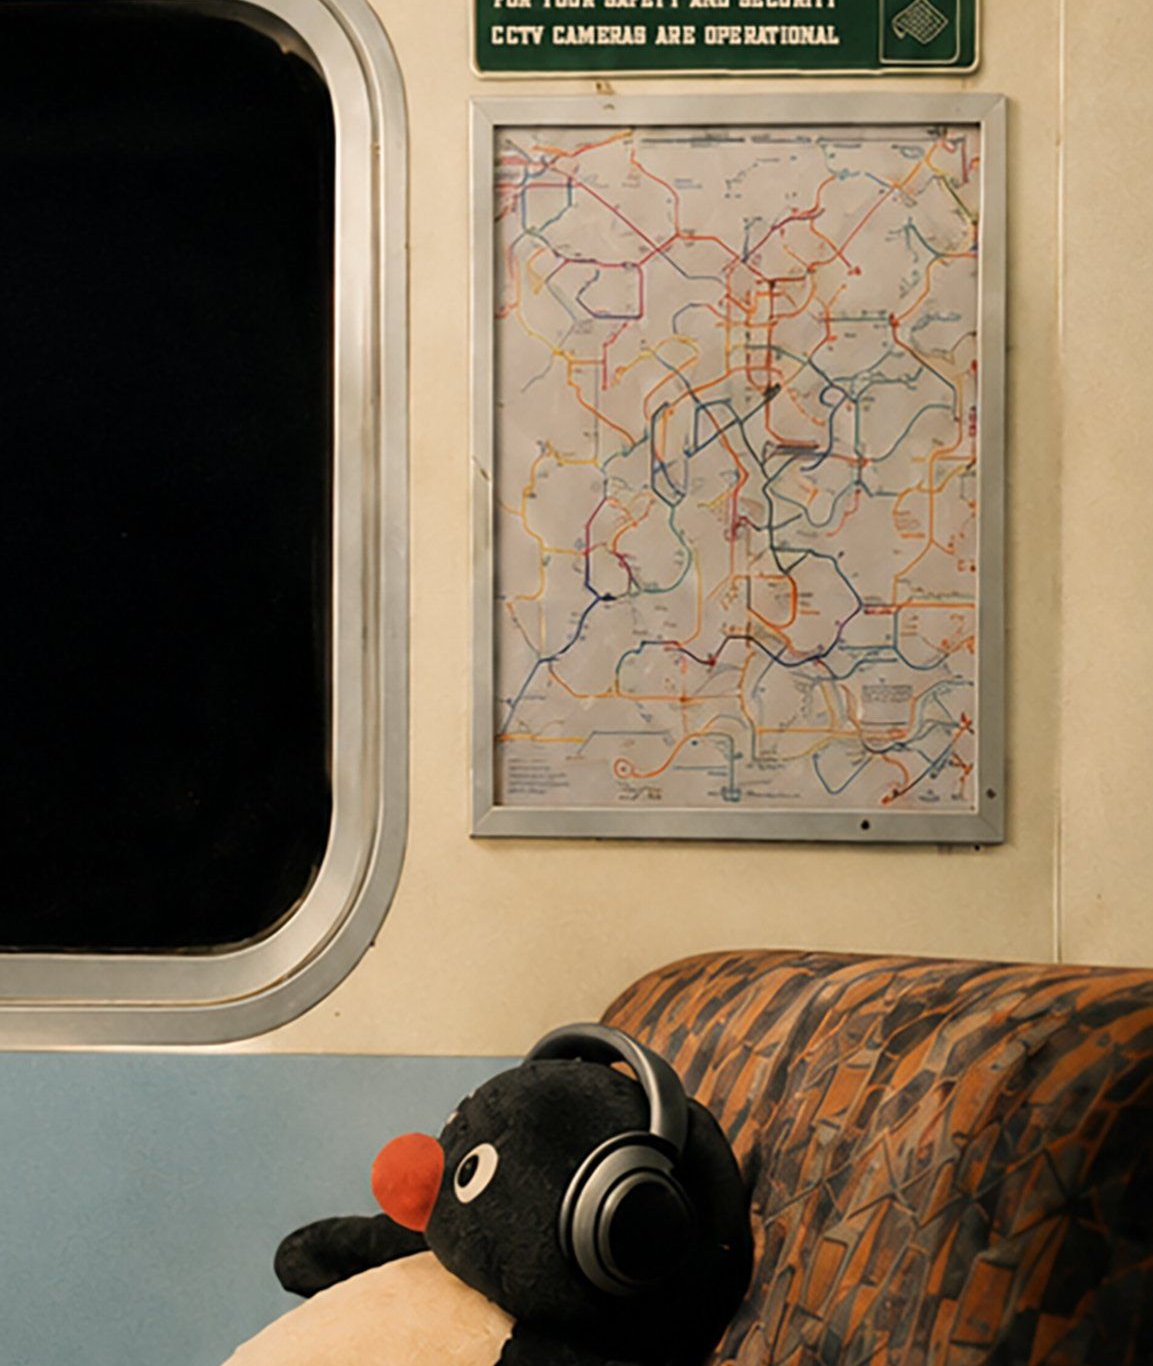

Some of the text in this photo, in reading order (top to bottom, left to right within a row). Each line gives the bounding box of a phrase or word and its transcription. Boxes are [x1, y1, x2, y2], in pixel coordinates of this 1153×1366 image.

[491, 25, 839, 45] CCTV CAMERAS ARE OPERATIONAL
